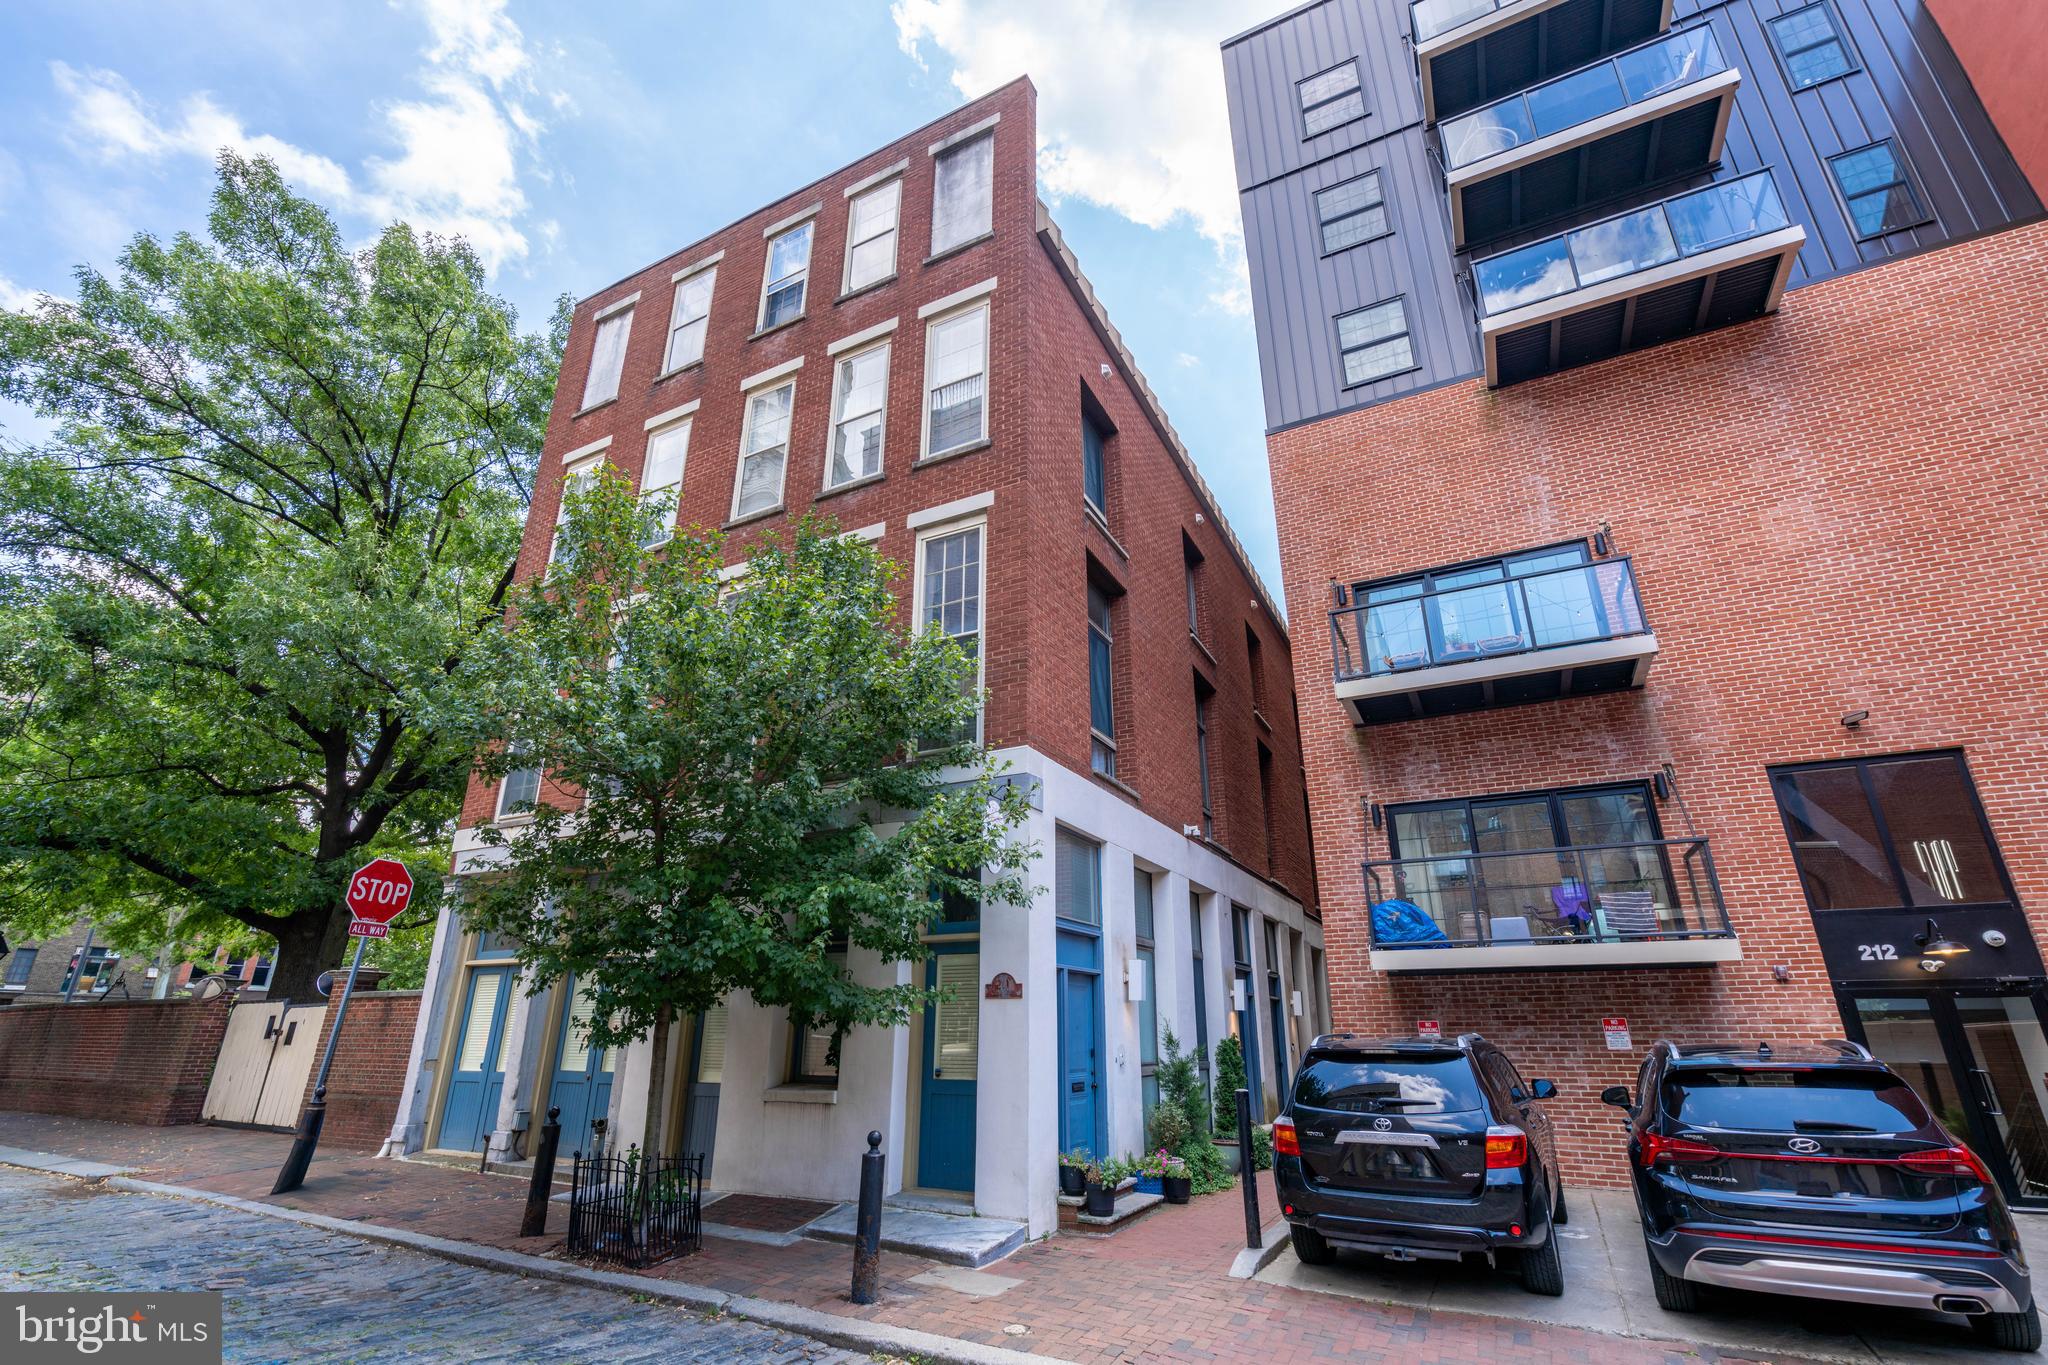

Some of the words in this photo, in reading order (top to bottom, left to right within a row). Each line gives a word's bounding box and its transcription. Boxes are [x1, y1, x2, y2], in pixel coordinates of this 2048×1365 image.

[352, 876, 408, 905] STOP
[351, 924, 367, 934] ALL
[369, 925, 386, 936] WAY
[1858, 944, 1898, 961] 212
